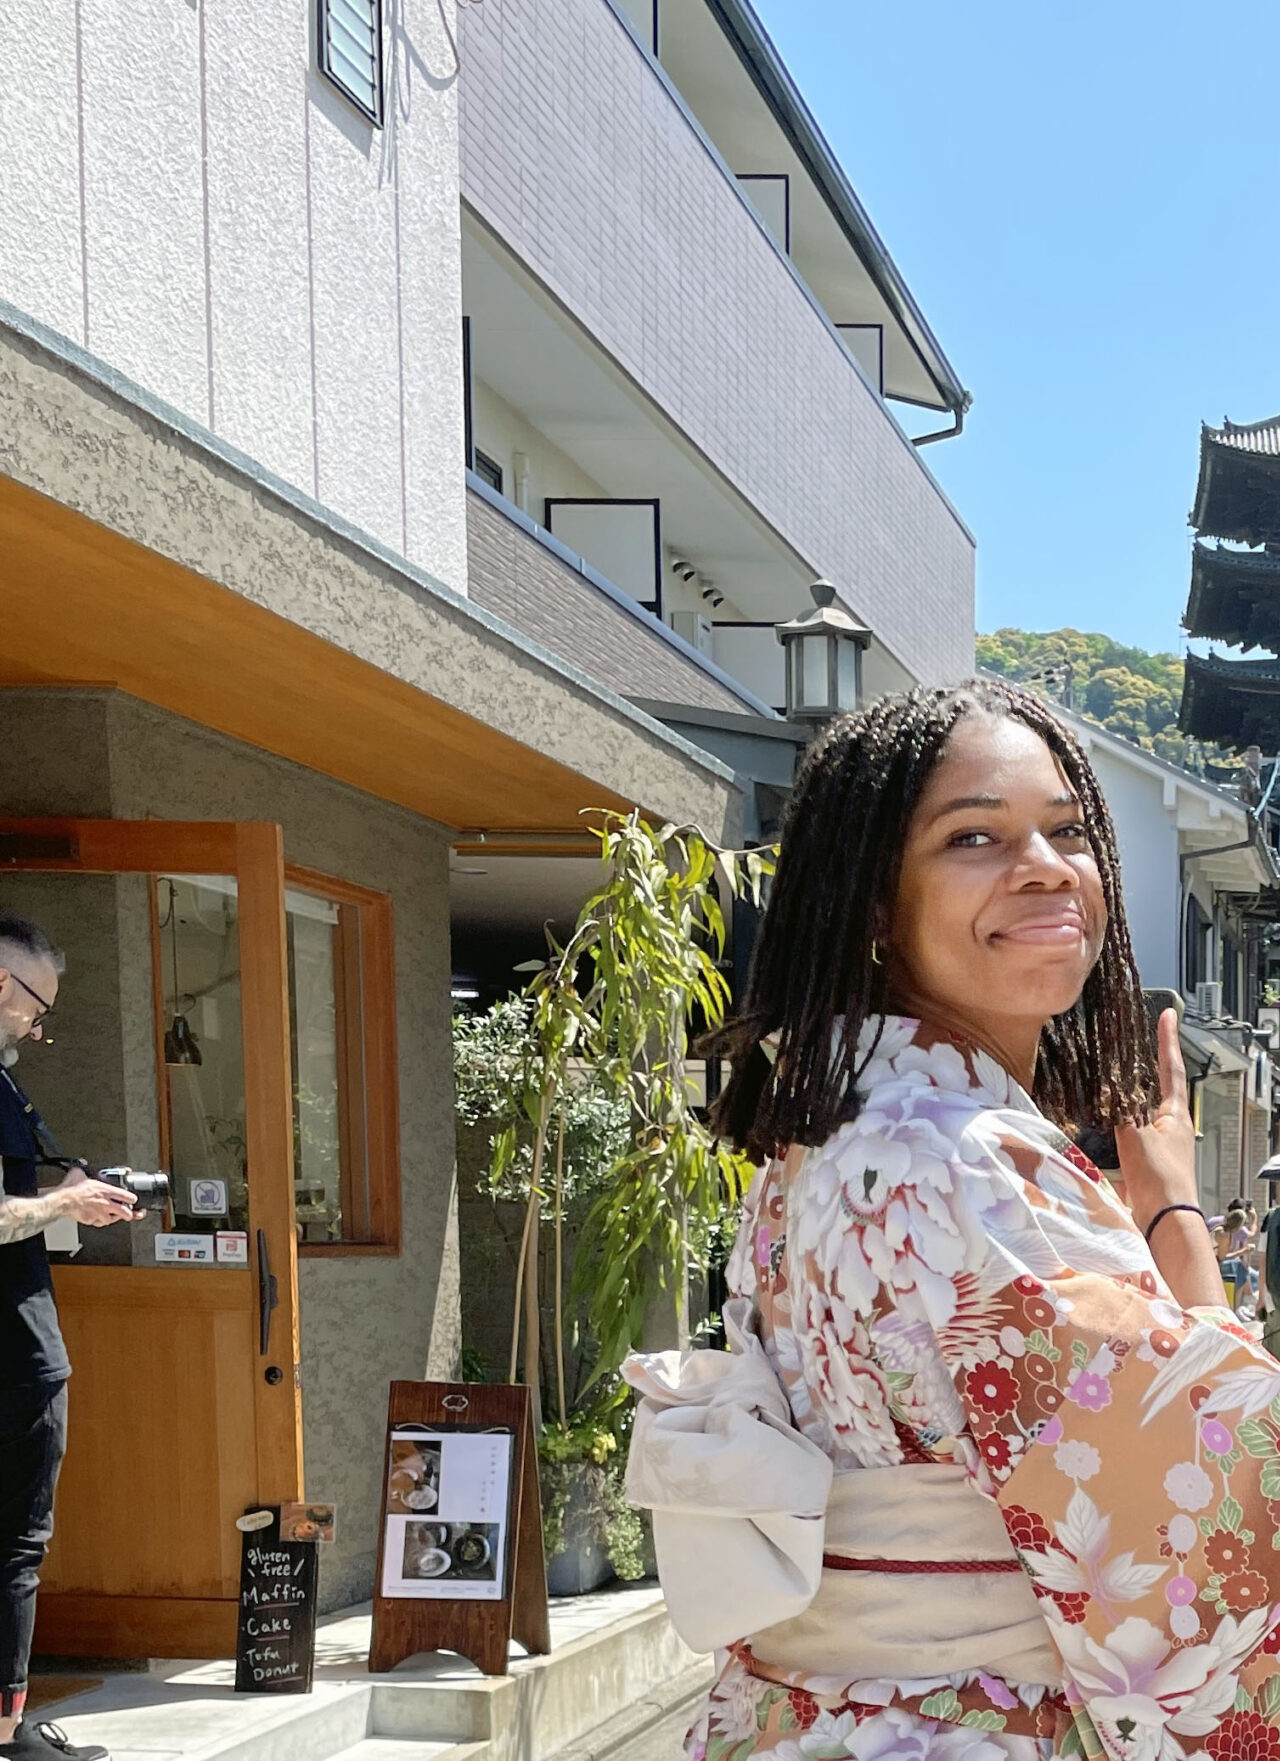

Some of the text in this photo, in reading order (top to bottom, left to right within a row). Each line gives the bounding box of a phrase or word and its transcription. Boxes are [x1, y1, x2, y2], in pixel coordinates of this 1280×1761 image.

[261, 1562, 291, 1577] free
[247, 1617, 292, 1636] Cake
[253, 1661, 299, 1682] Donut
